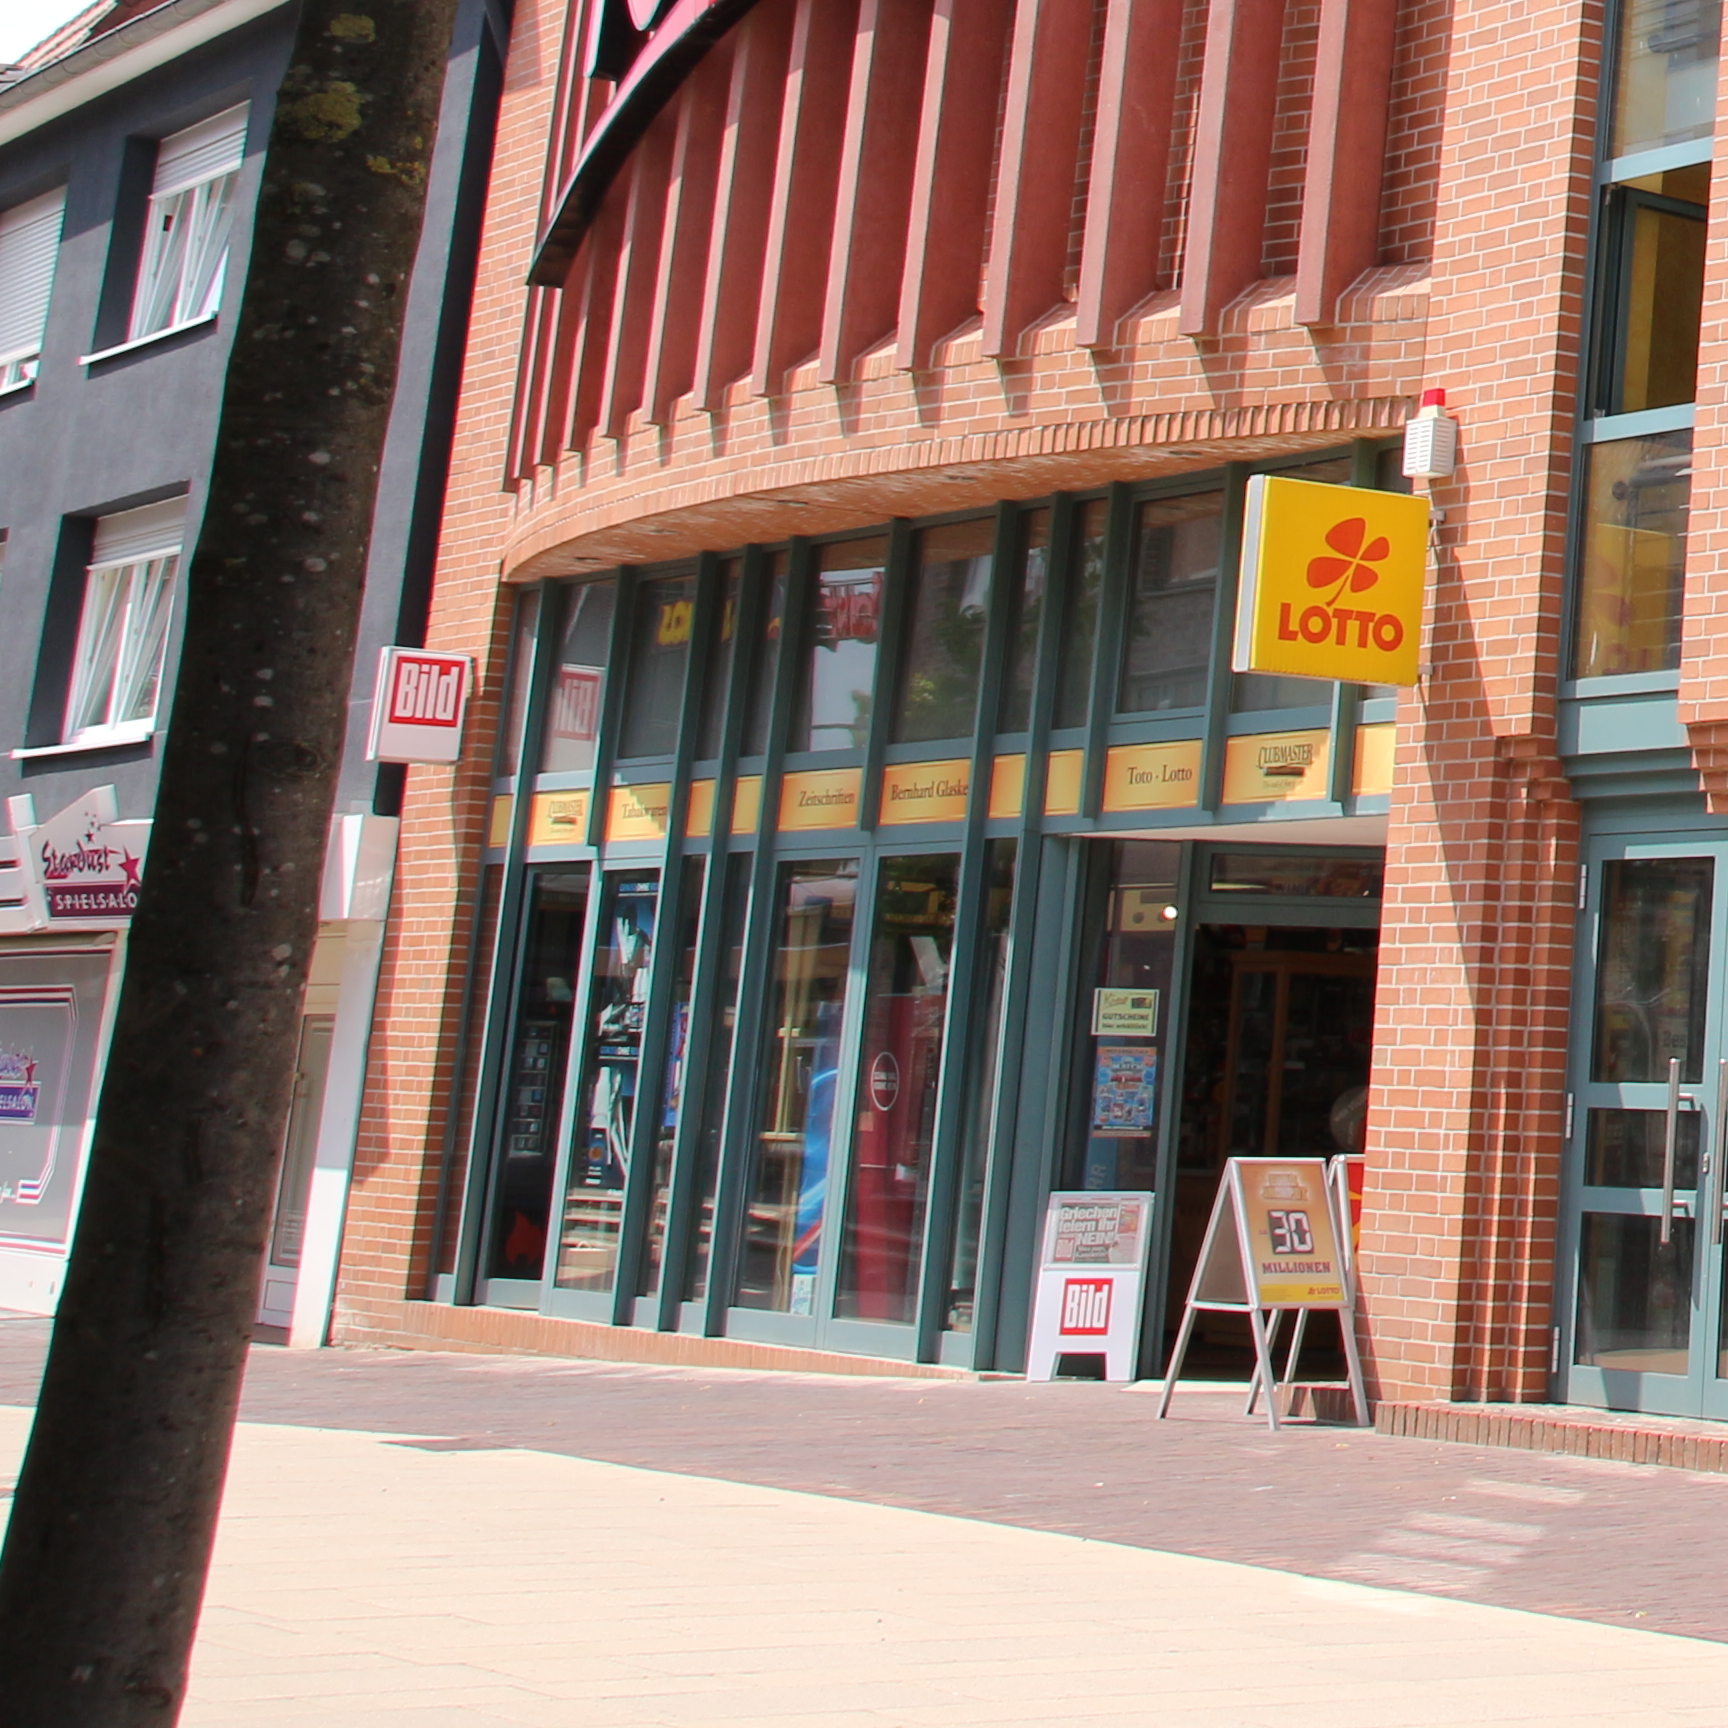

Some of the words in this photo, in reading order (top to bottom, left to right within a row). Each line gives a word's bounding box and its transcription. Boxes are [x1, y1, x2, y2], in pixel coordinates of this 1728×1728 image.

[1278, 602, 1404, 652] LOTTO
[394, 662, 459, 722] Bild
[1128, 766, 1153, 785] Toto
[1162, 765, 1193, 783] Lotto
[799, 791, 855, 808] Zeitschriften
[890, 781, 934, 801] Bernhard
[56, 892, 138, 910] SPIELSALO
[1061, 1206, 1118, 1220] Griechen
[1270, 1210, 1312, 1254] 30
[1262, 1262, 1331, 1274] MILLIONEN
[1063, 1284, 1110, 1328] Bild
